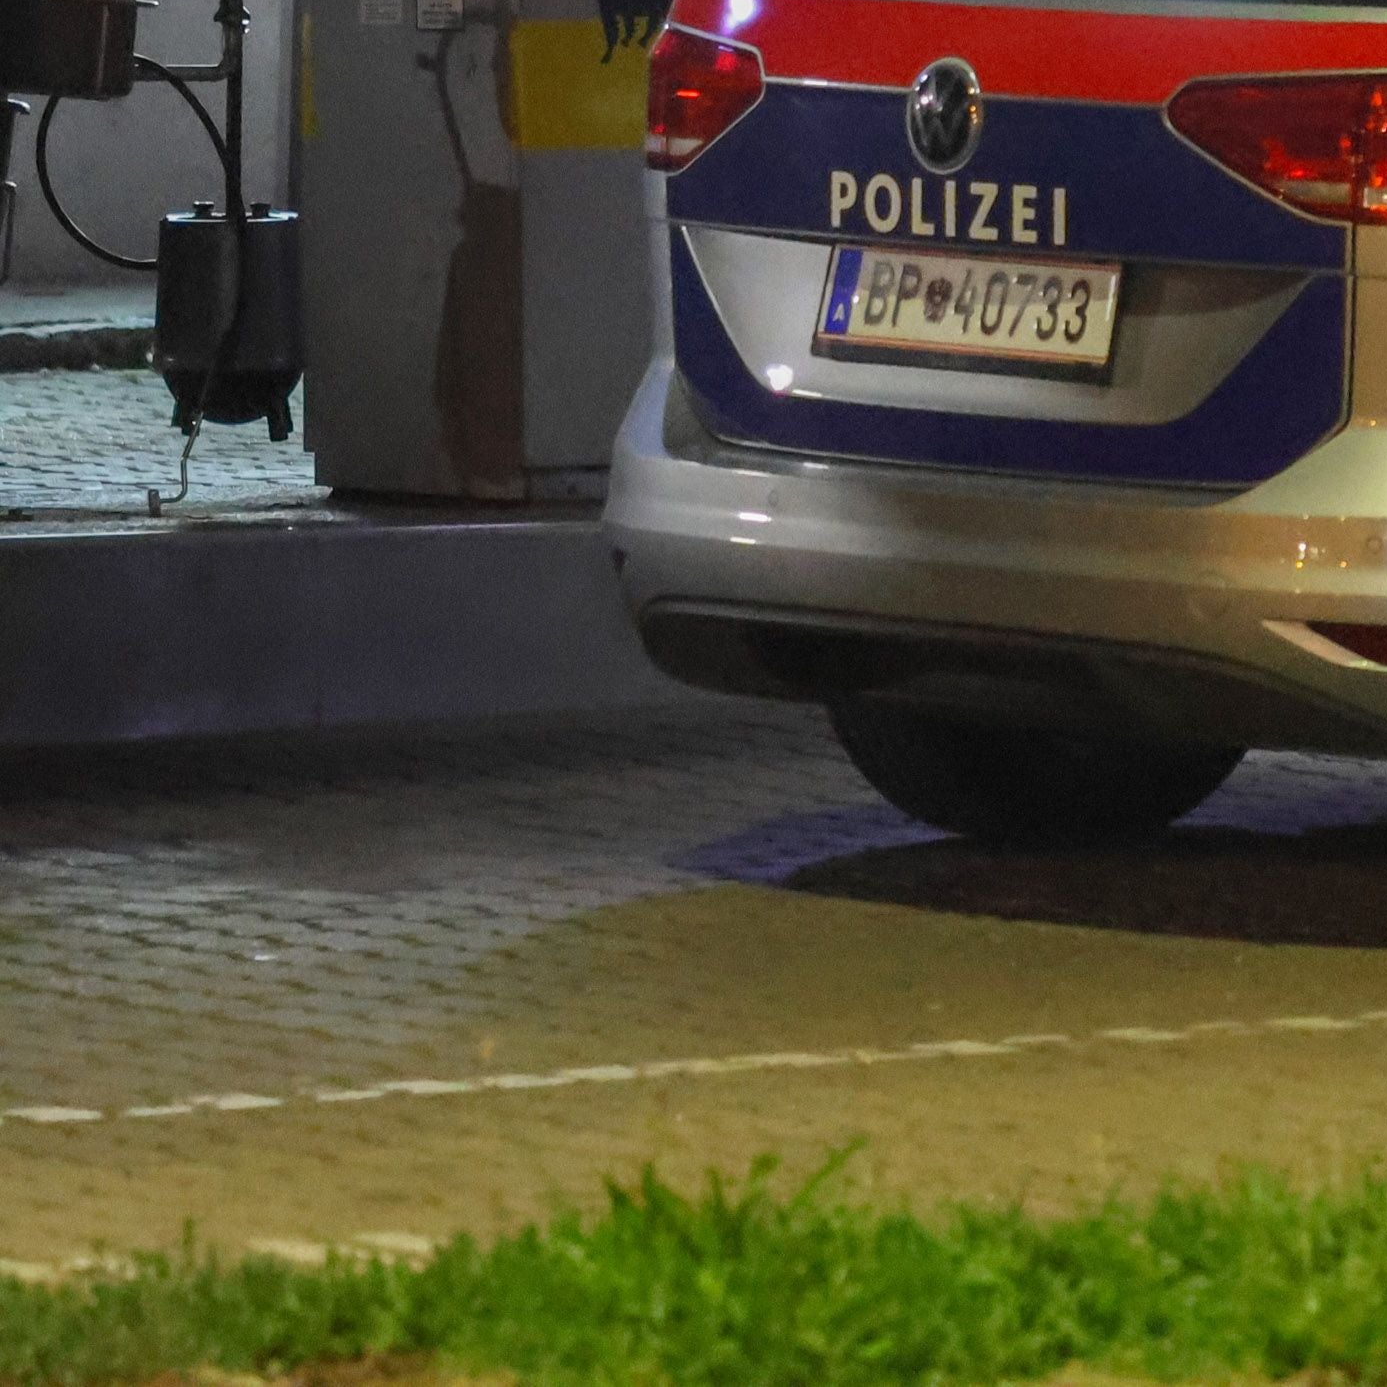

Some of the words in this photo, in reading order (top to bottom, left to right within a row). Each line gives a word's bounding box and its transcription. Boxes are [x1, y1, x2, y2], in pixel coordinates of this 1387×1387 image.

[828, 169, 1067, 247] POLIZEI
[832, 306, 846, 323] A
[863, 258, 924, 328] BP
[953, 267, 1092, 345] 40733
